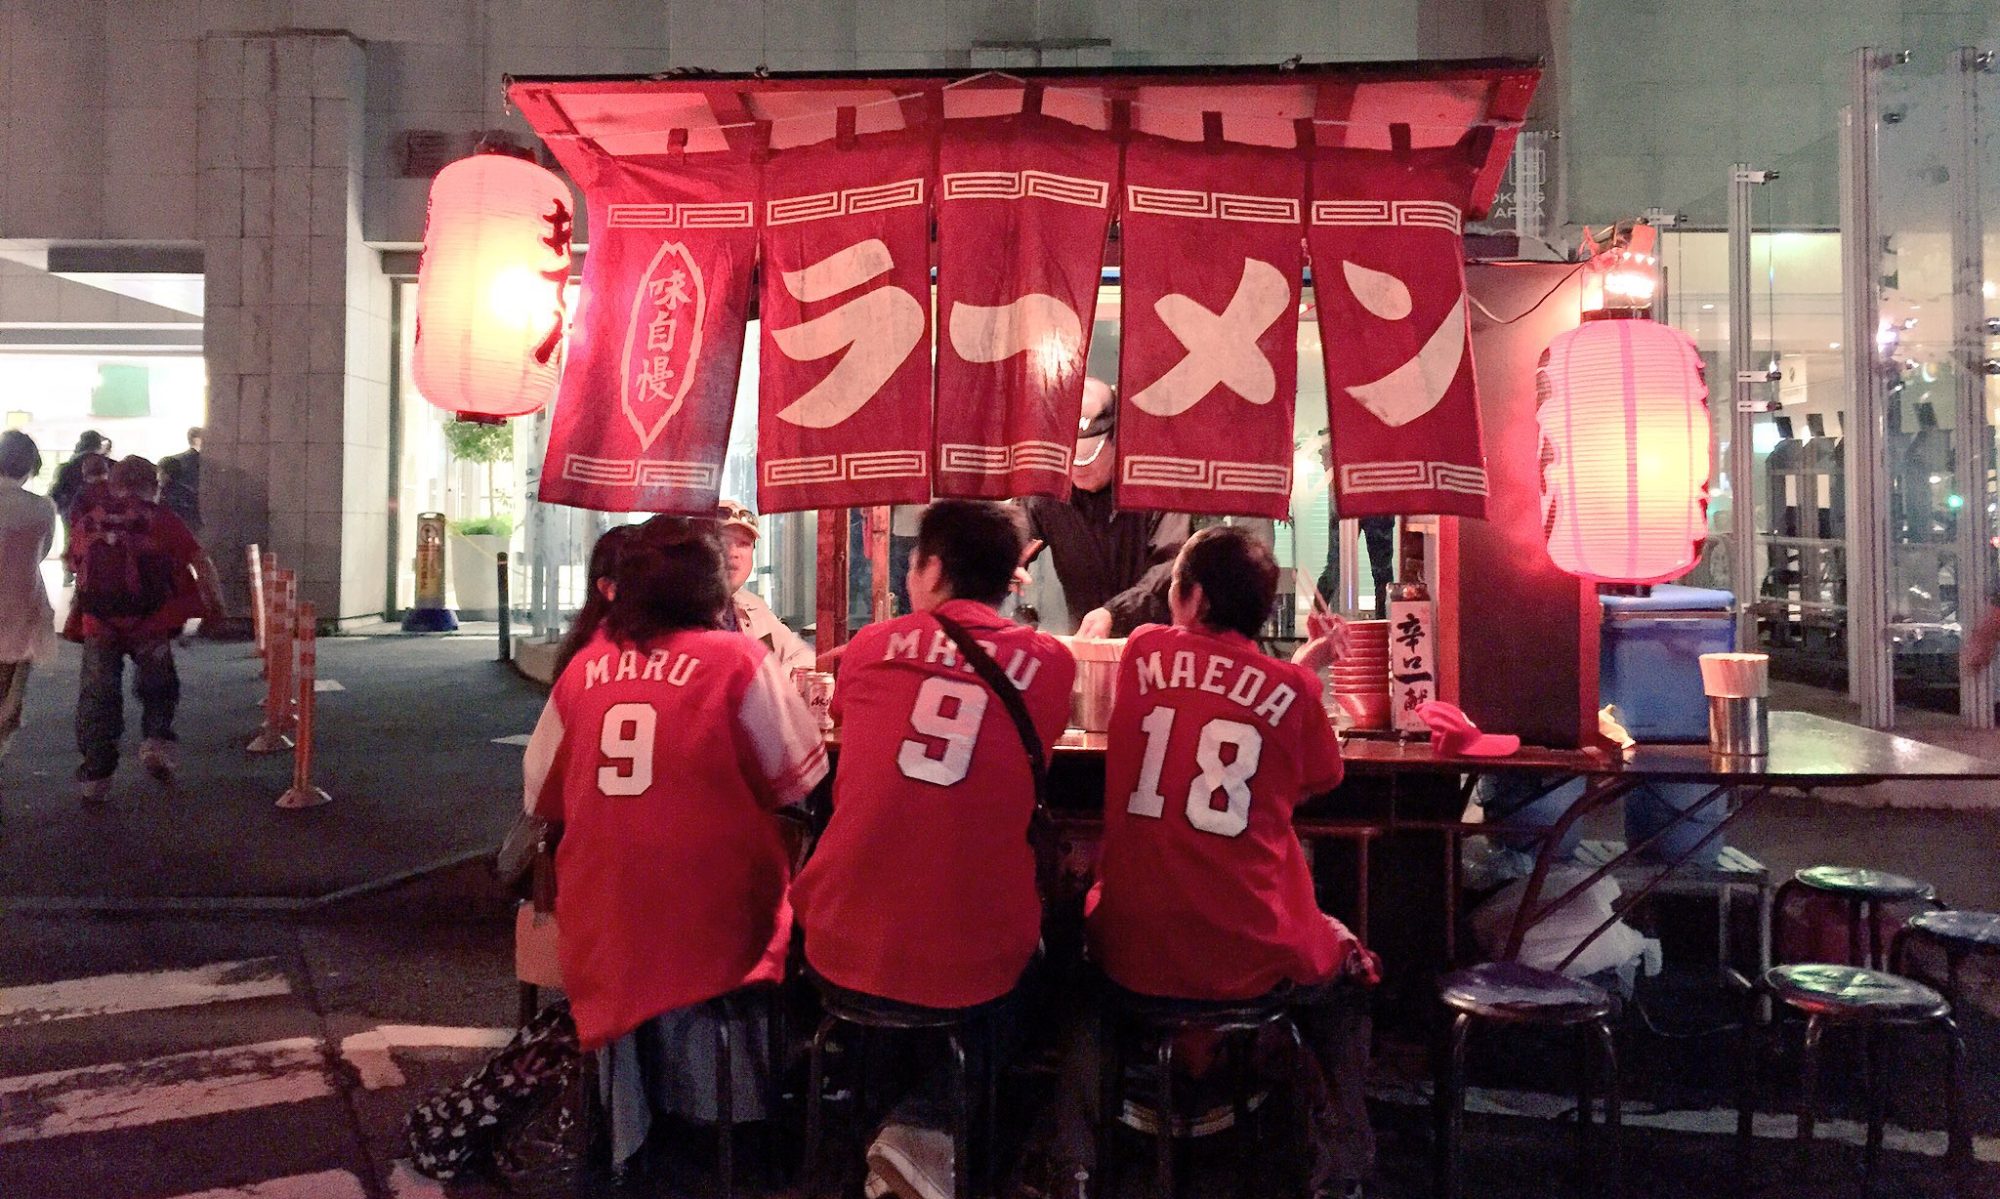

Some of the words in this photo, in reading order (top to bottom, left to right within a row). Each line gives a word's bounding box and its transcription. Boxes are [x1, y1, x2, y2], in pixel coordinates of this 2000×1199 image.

[636, 270, 692, 401] 味自慢
[770, 238, 1466, 428] ラーメン
[585, 649, 700, 690] MARU
[1136, 651, 1297, 728] MAEDA
[1395, 613, 1432, 711] 辛口一献
[598, 703, 657, 796] 9
[898, 676, 988, 787] 9
[1127, 706, 1263, 838] 18
